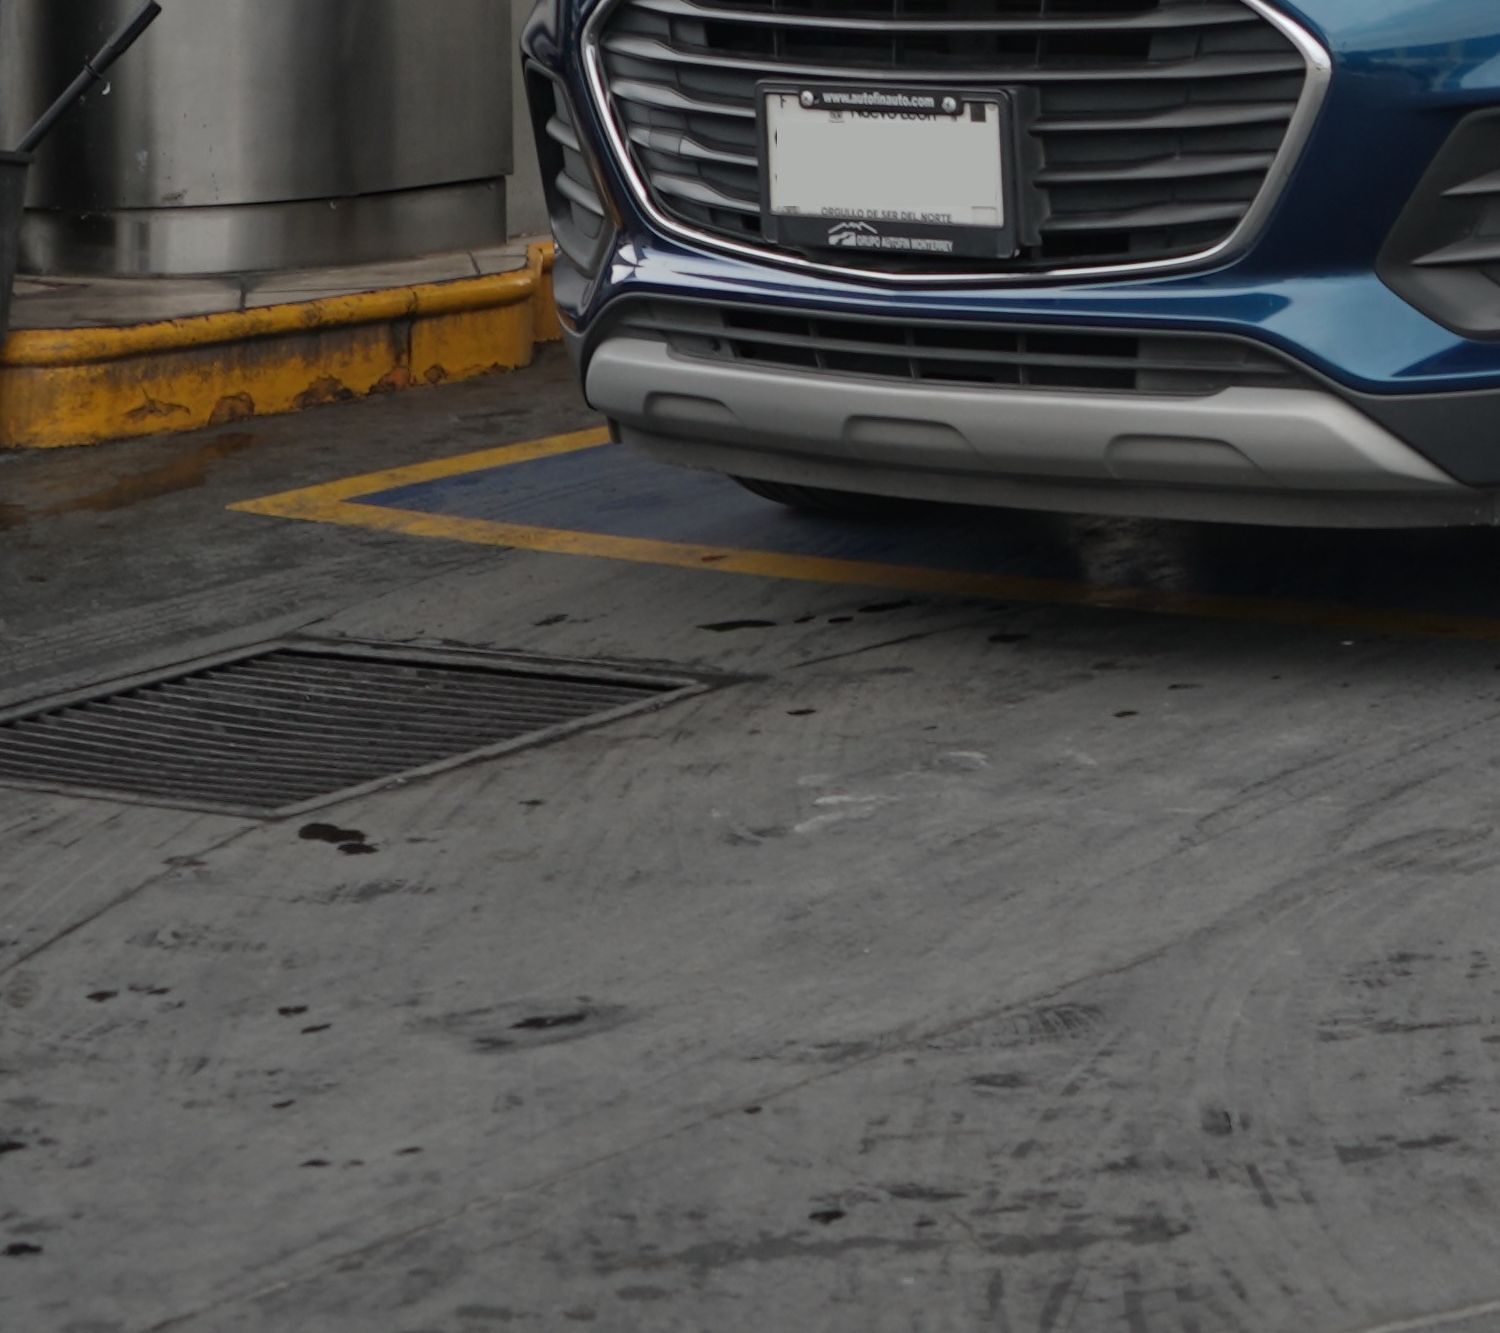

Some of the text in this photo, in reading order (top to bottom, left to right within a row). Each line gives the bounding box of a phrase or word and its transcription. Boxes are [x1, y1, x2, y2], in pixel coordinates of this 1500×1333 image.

[822, 91, 935, 109] www.autofinauto.com
[821, 206, 952, 224] ORGULLO DE SER DEL NORTE
[856, 234, 881, 249] GRUPO
